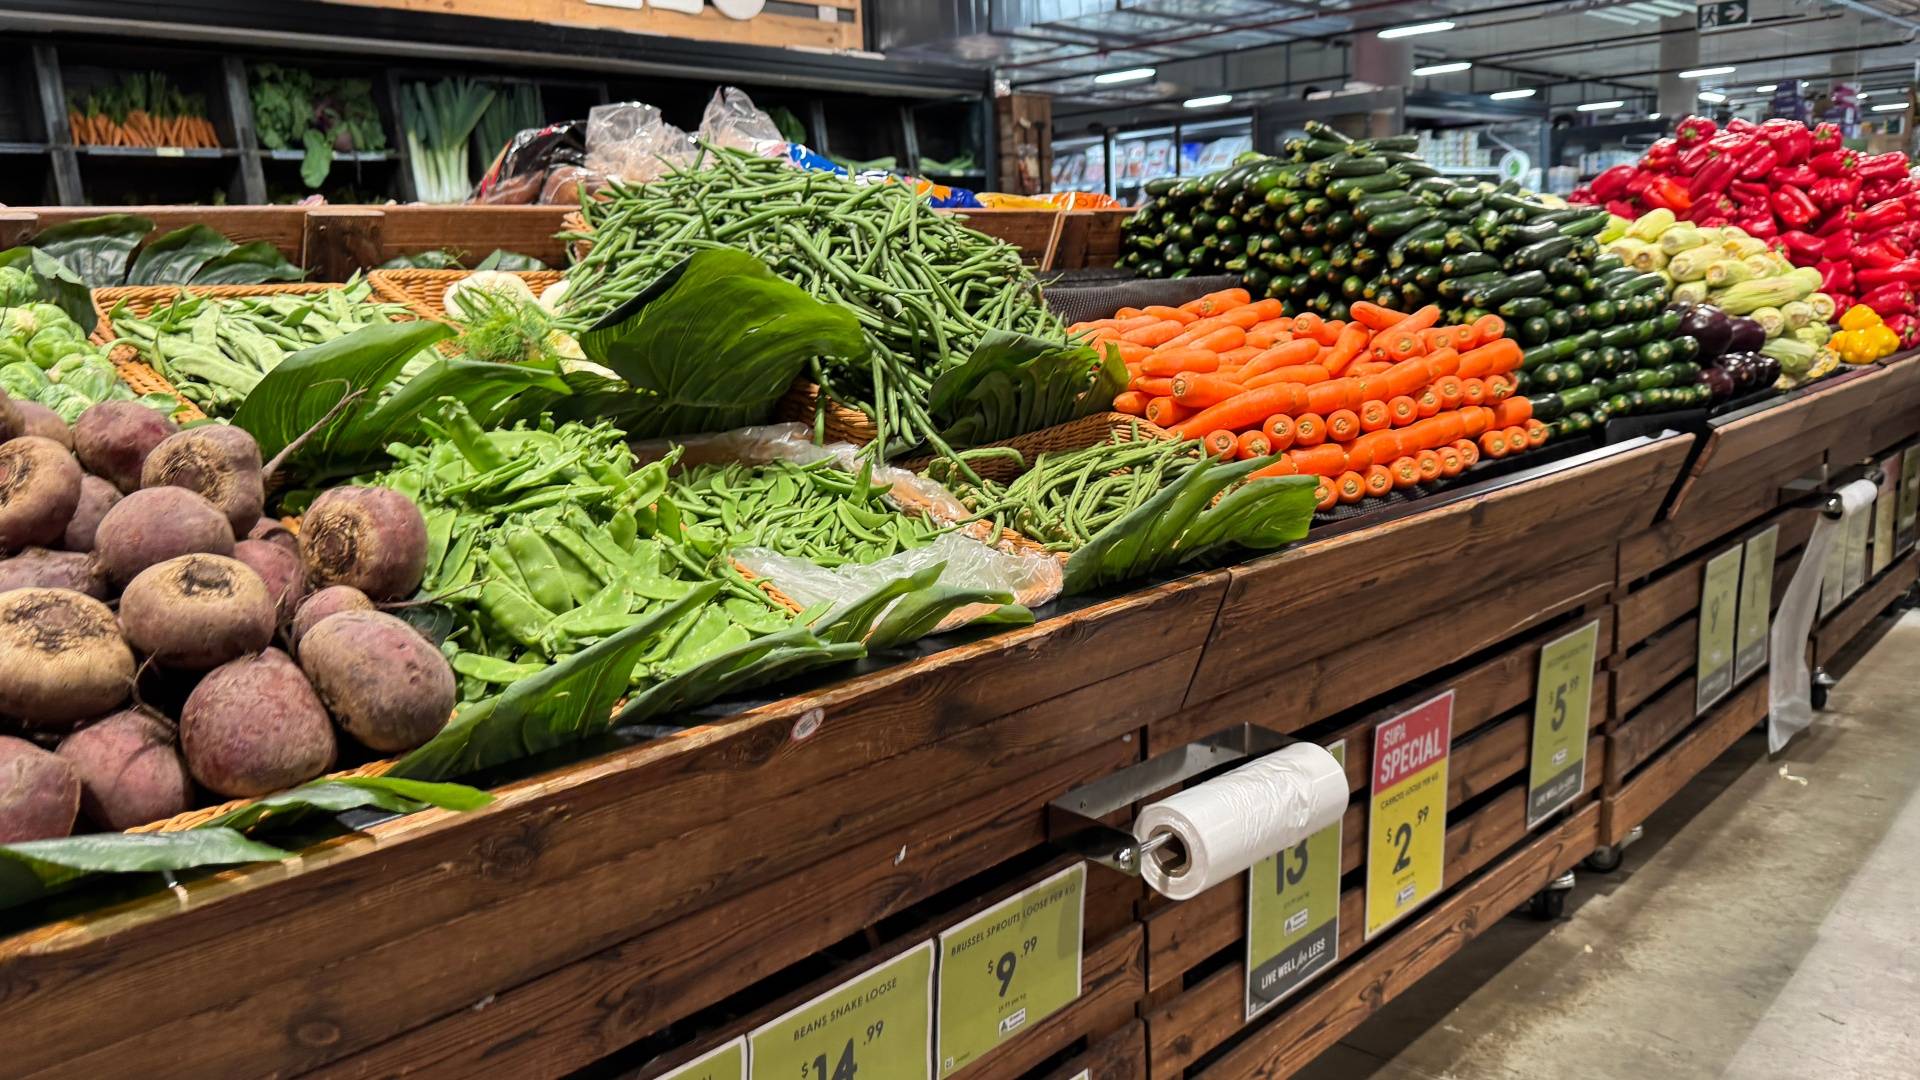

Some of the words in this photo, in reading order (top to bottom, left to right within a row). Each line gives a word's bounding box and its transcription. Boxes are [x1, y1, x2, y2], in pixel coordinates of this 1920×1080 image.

[1381, 727, 1442, 784] SPECIAL
[951, 932, 984, 956] BRUSSEL
[986, 912, 1021, 938] SPROUTS
[1022, 896, 1049, 920] LOOSE
[1261, 969, 1277, 990] LIVE
[1278, 957, 1296, 979] WELL
[1308, 937, 1326, 959] LESS
[793, 1017, 828, 1042] BEANS
[830, 998, 864, 1023] SNAKE
[865, 976, 897, 1003] LOOSE
